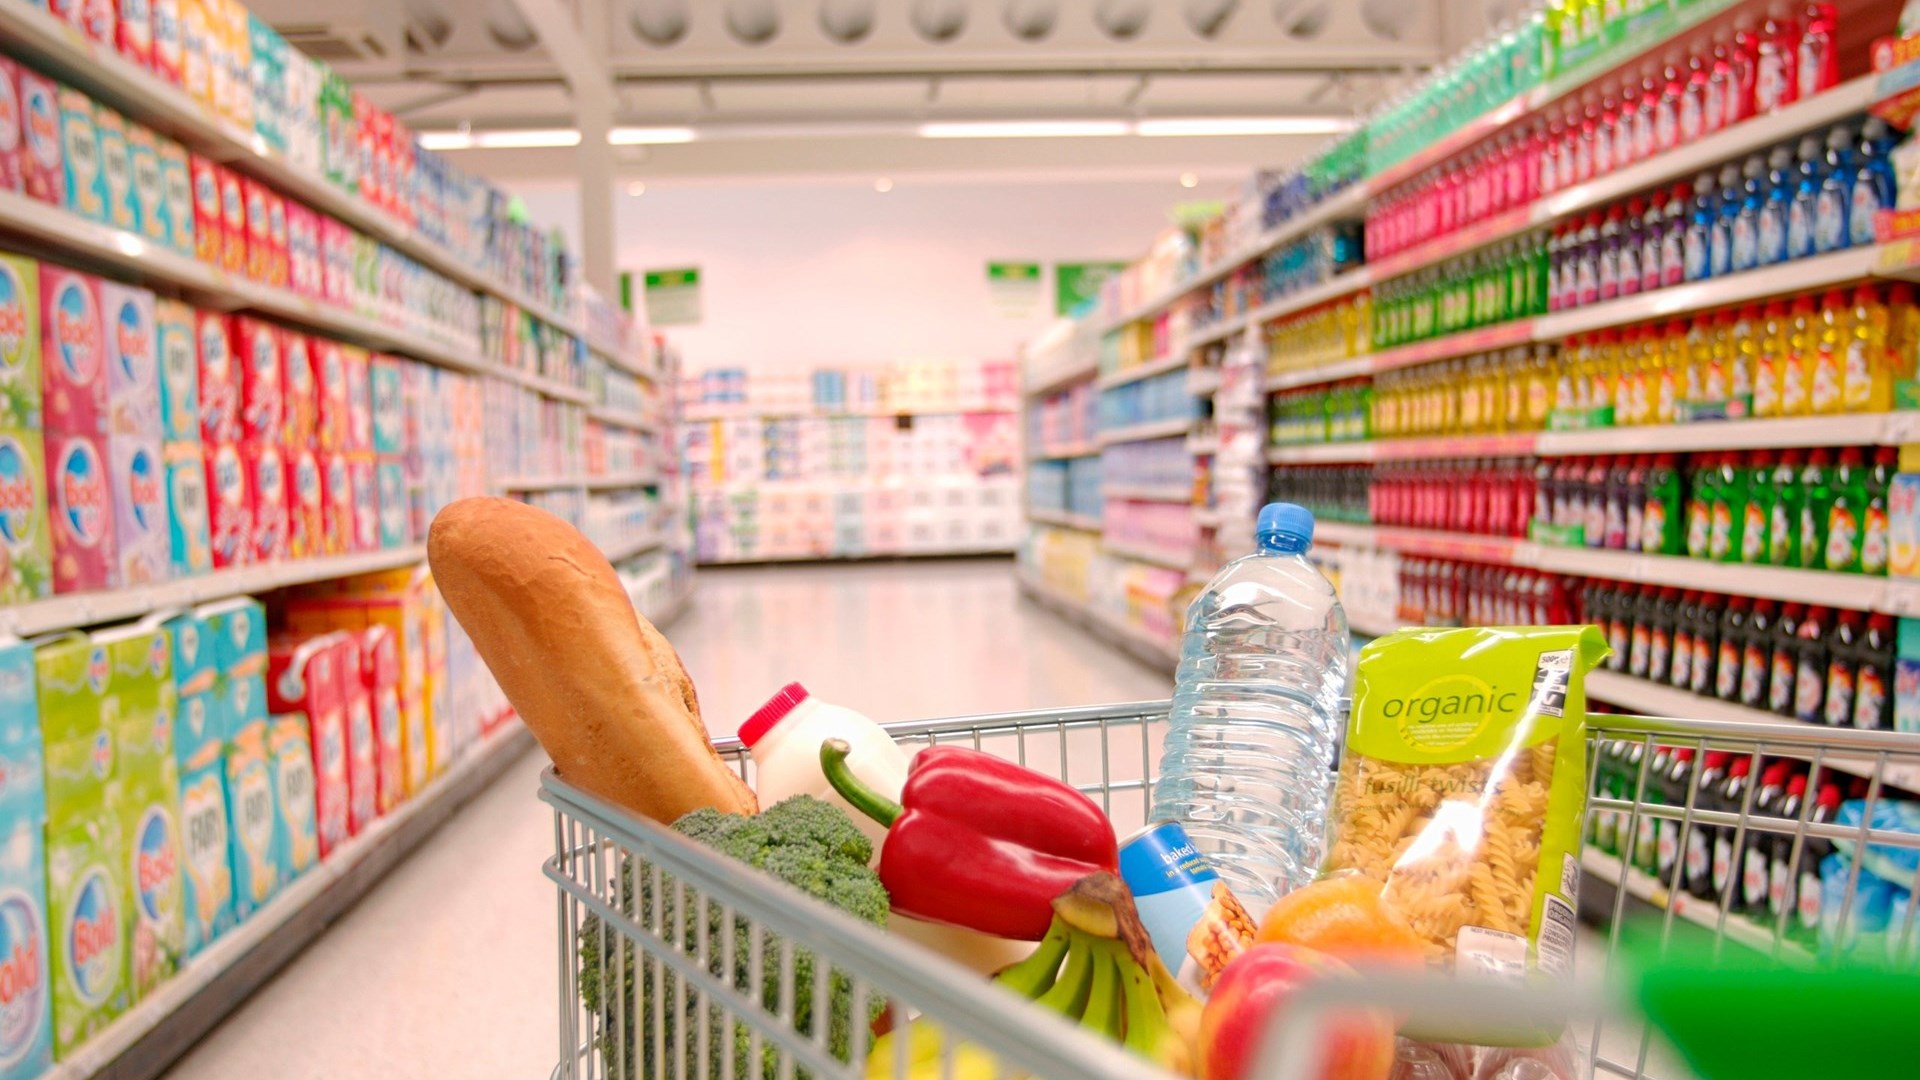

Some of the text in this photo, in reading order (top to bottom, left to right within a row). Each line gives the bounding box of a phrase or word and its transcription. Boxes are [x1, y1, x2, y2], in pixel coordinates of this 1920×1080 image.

[1383, 685, 1517, 723] organic
[1364, 774, 1420, 794] fusilli
[1160, 841, 1194, 865] baked
[74, 904, 115, 967] Bold
[0, 931, 39, 1005] old
